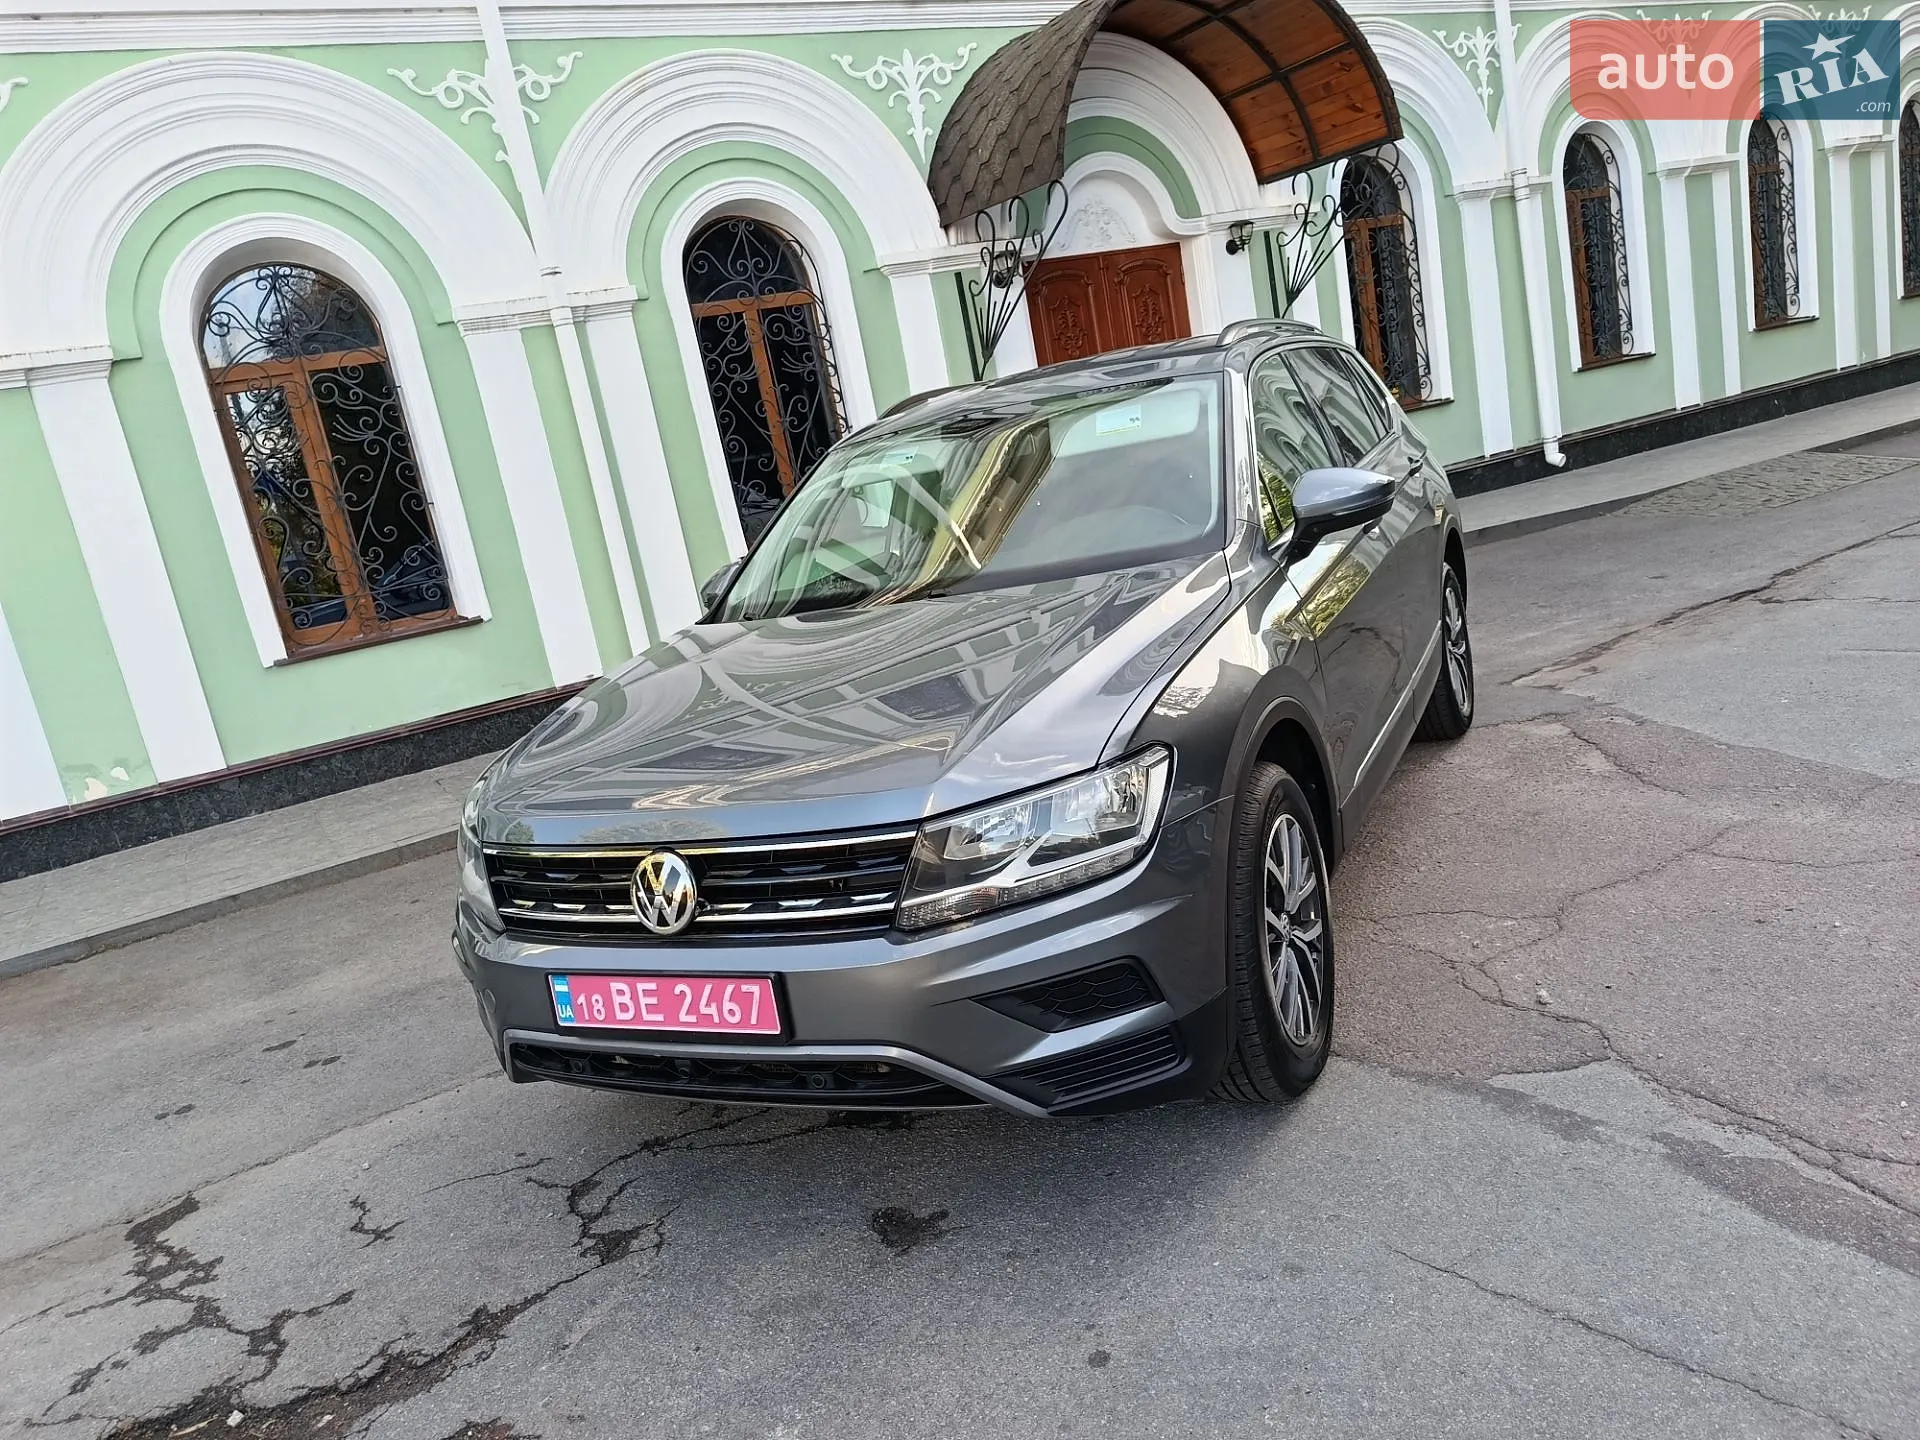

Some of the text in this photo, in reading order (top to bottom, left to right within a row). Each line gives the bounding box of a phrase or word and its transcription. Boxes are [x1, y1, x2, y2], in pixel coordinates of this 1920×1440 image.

[558, 1003, 574, 1019] UA
[576, 982, 760, 1025] 18 BE 2467
